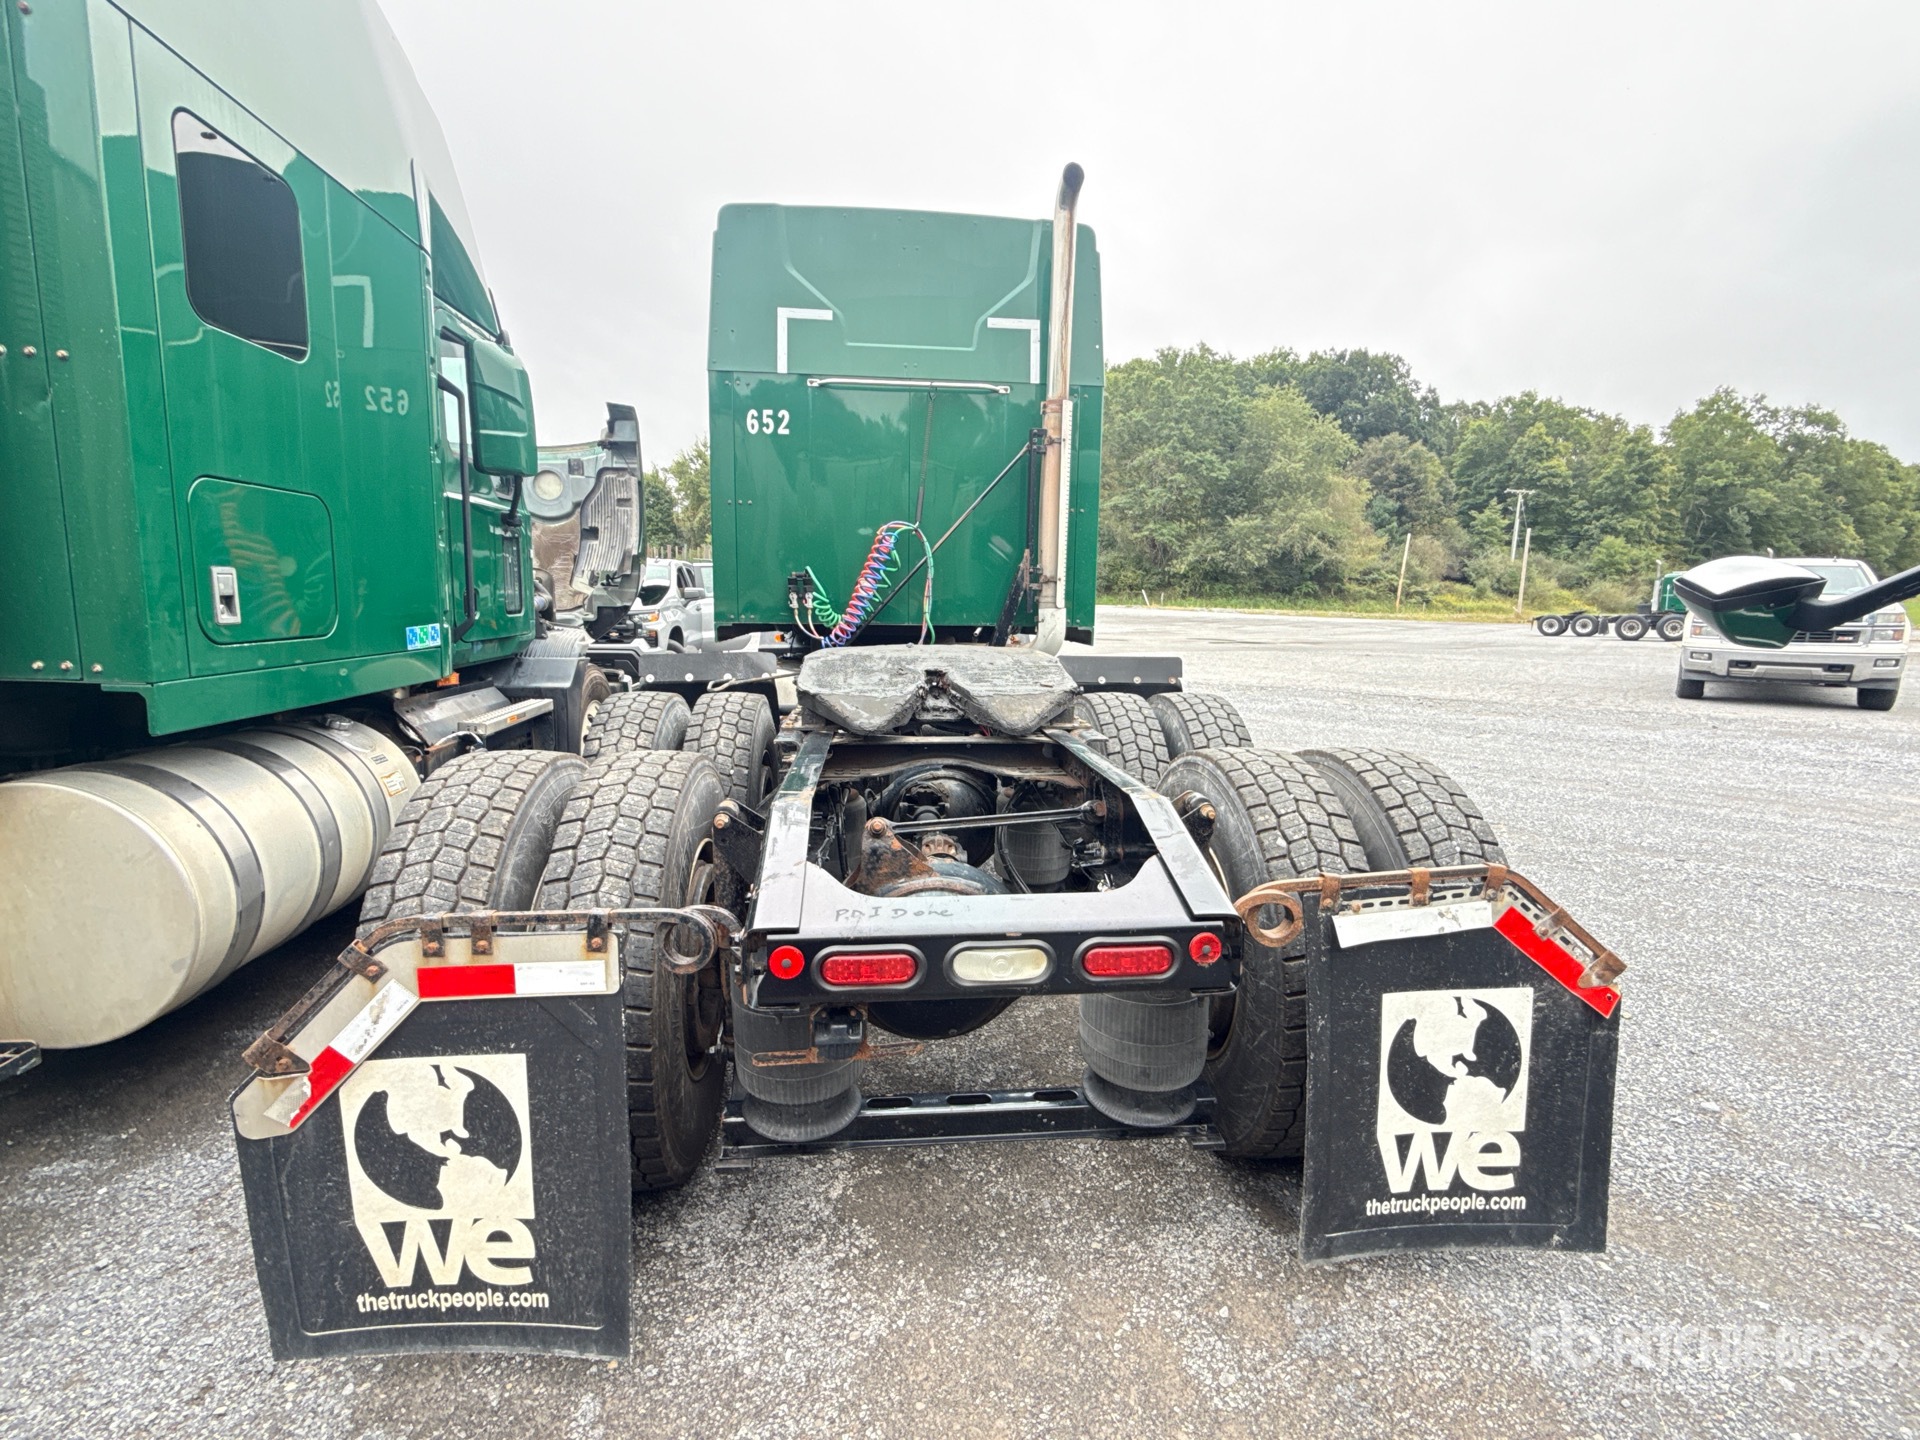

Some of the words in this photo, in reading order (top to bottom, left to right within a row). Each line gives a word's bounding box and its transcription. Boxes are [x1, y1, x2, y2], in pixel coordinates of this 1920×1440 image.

[746, 408, 790, 435] 652
[1366, 1193, 1527, 1216] thetruckpeople.com
[356, 1288, 550, 1313] thetruckpeople.com
